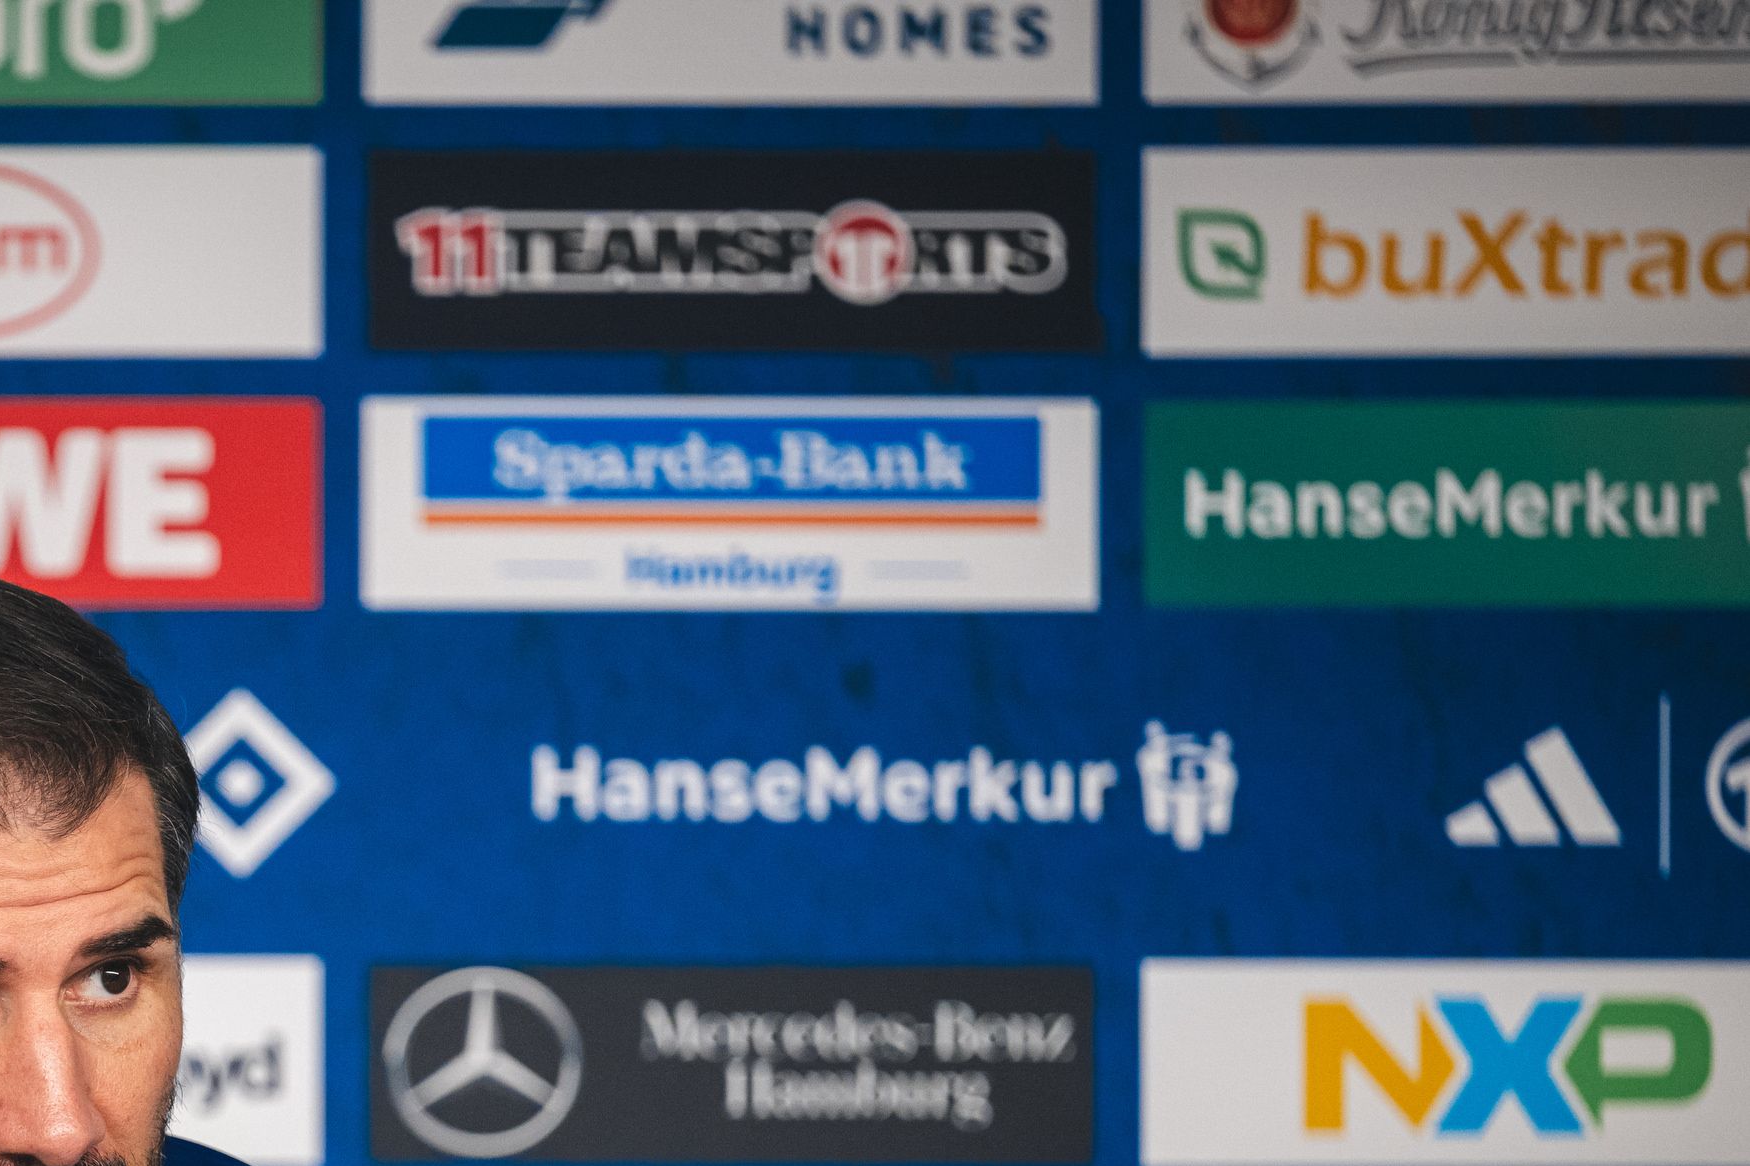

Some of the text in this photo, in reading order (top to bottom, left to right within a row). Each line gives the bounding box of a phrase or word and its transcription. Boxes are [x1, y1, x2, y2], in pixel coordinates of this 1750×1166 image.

[785, 7, 1051, 57] HOMES
[492, 427, 969, 506] Sparda-Bank
[1182, 466, 1720, 541] HanseMerkur
[621, 544, 842, 606] Hamburg
[529, 743, 1119, 825] HanseMerkur
[642, 999, 1077, 1065] Mercedes-Benz
[1300, 991, 1715, 1141] NXP
[722, 1060, 995, 1133] Hamburg
